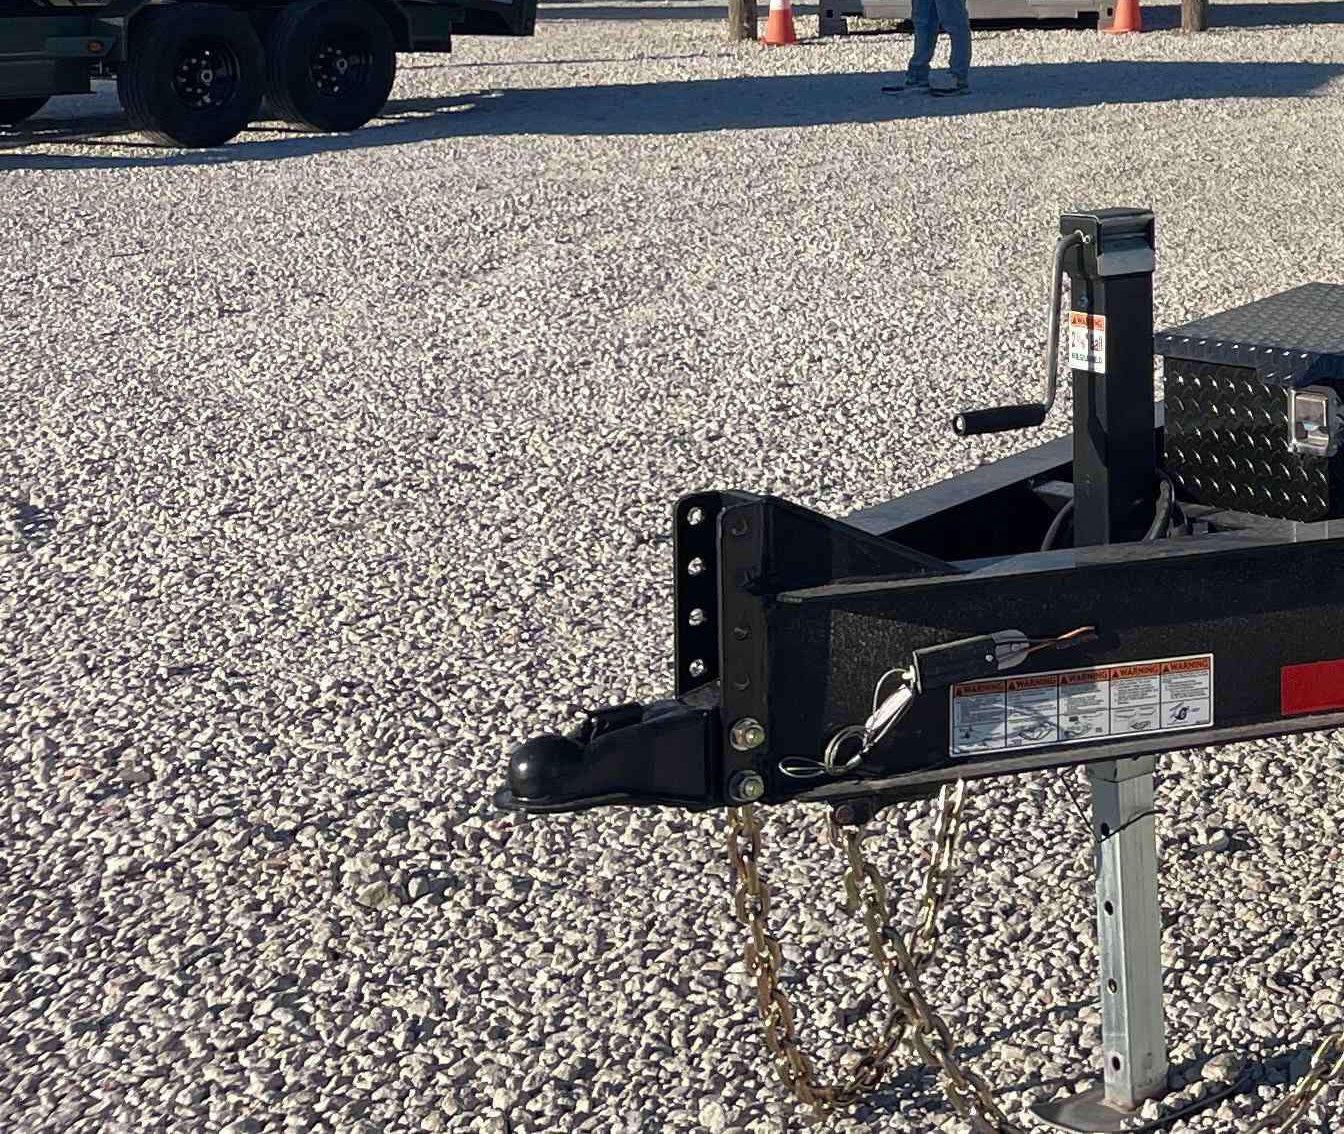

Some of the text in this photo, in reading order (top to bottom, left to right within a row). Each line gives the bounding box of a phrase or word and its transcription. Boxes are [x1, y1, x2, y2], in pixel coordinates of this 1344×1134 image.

[1119, 665, 1159, 677] WARNING
[1170, 659, 1208, 671] WARNING
[1015, 676, 1057, 689] WARNING
[1067, 670, 1108, 684] WARNING
